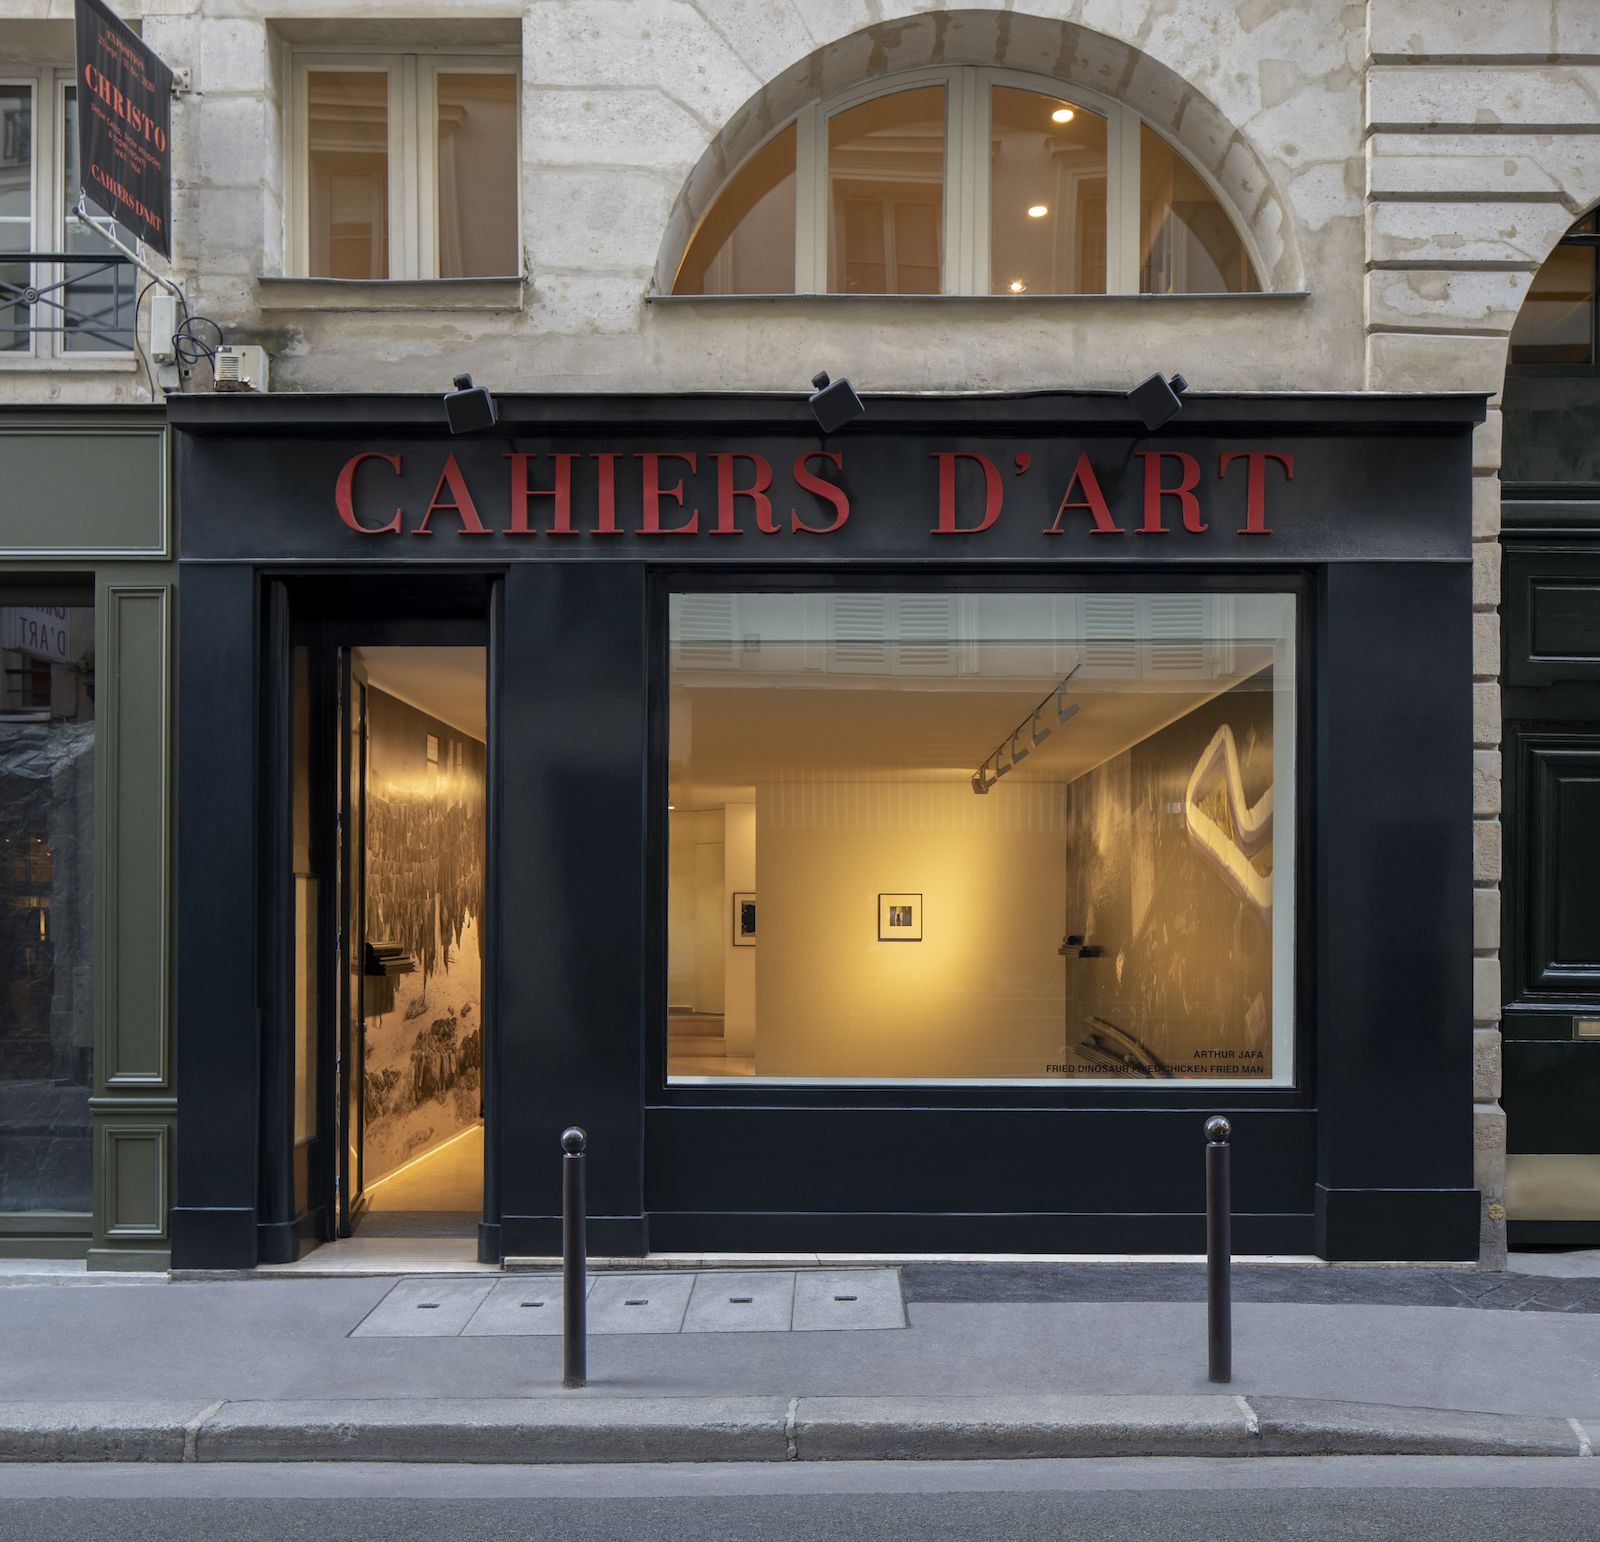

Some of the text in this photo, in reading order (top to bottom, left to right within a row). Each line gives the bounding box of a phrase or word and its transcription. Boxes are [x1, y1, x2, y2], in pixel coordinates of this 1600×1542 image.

[85, 63, 166, 152] CHRISTO
[91, 163, 135, 209] CAHIERS
[335, 450, 851, 535] CAHIERS
[1045, 1064, 1075, 1073] FRIED
[1077, 1064, 1129, 1073] DINOSAUR
[1163, 1064, 1208, 1073] CHICKEN
[1210, 1065, 1239, 1073] FRIED
[1241, 1065, 1264, 1073] MAN
[1193, 1050, 1264, 1060] ARTHUR JAFA
